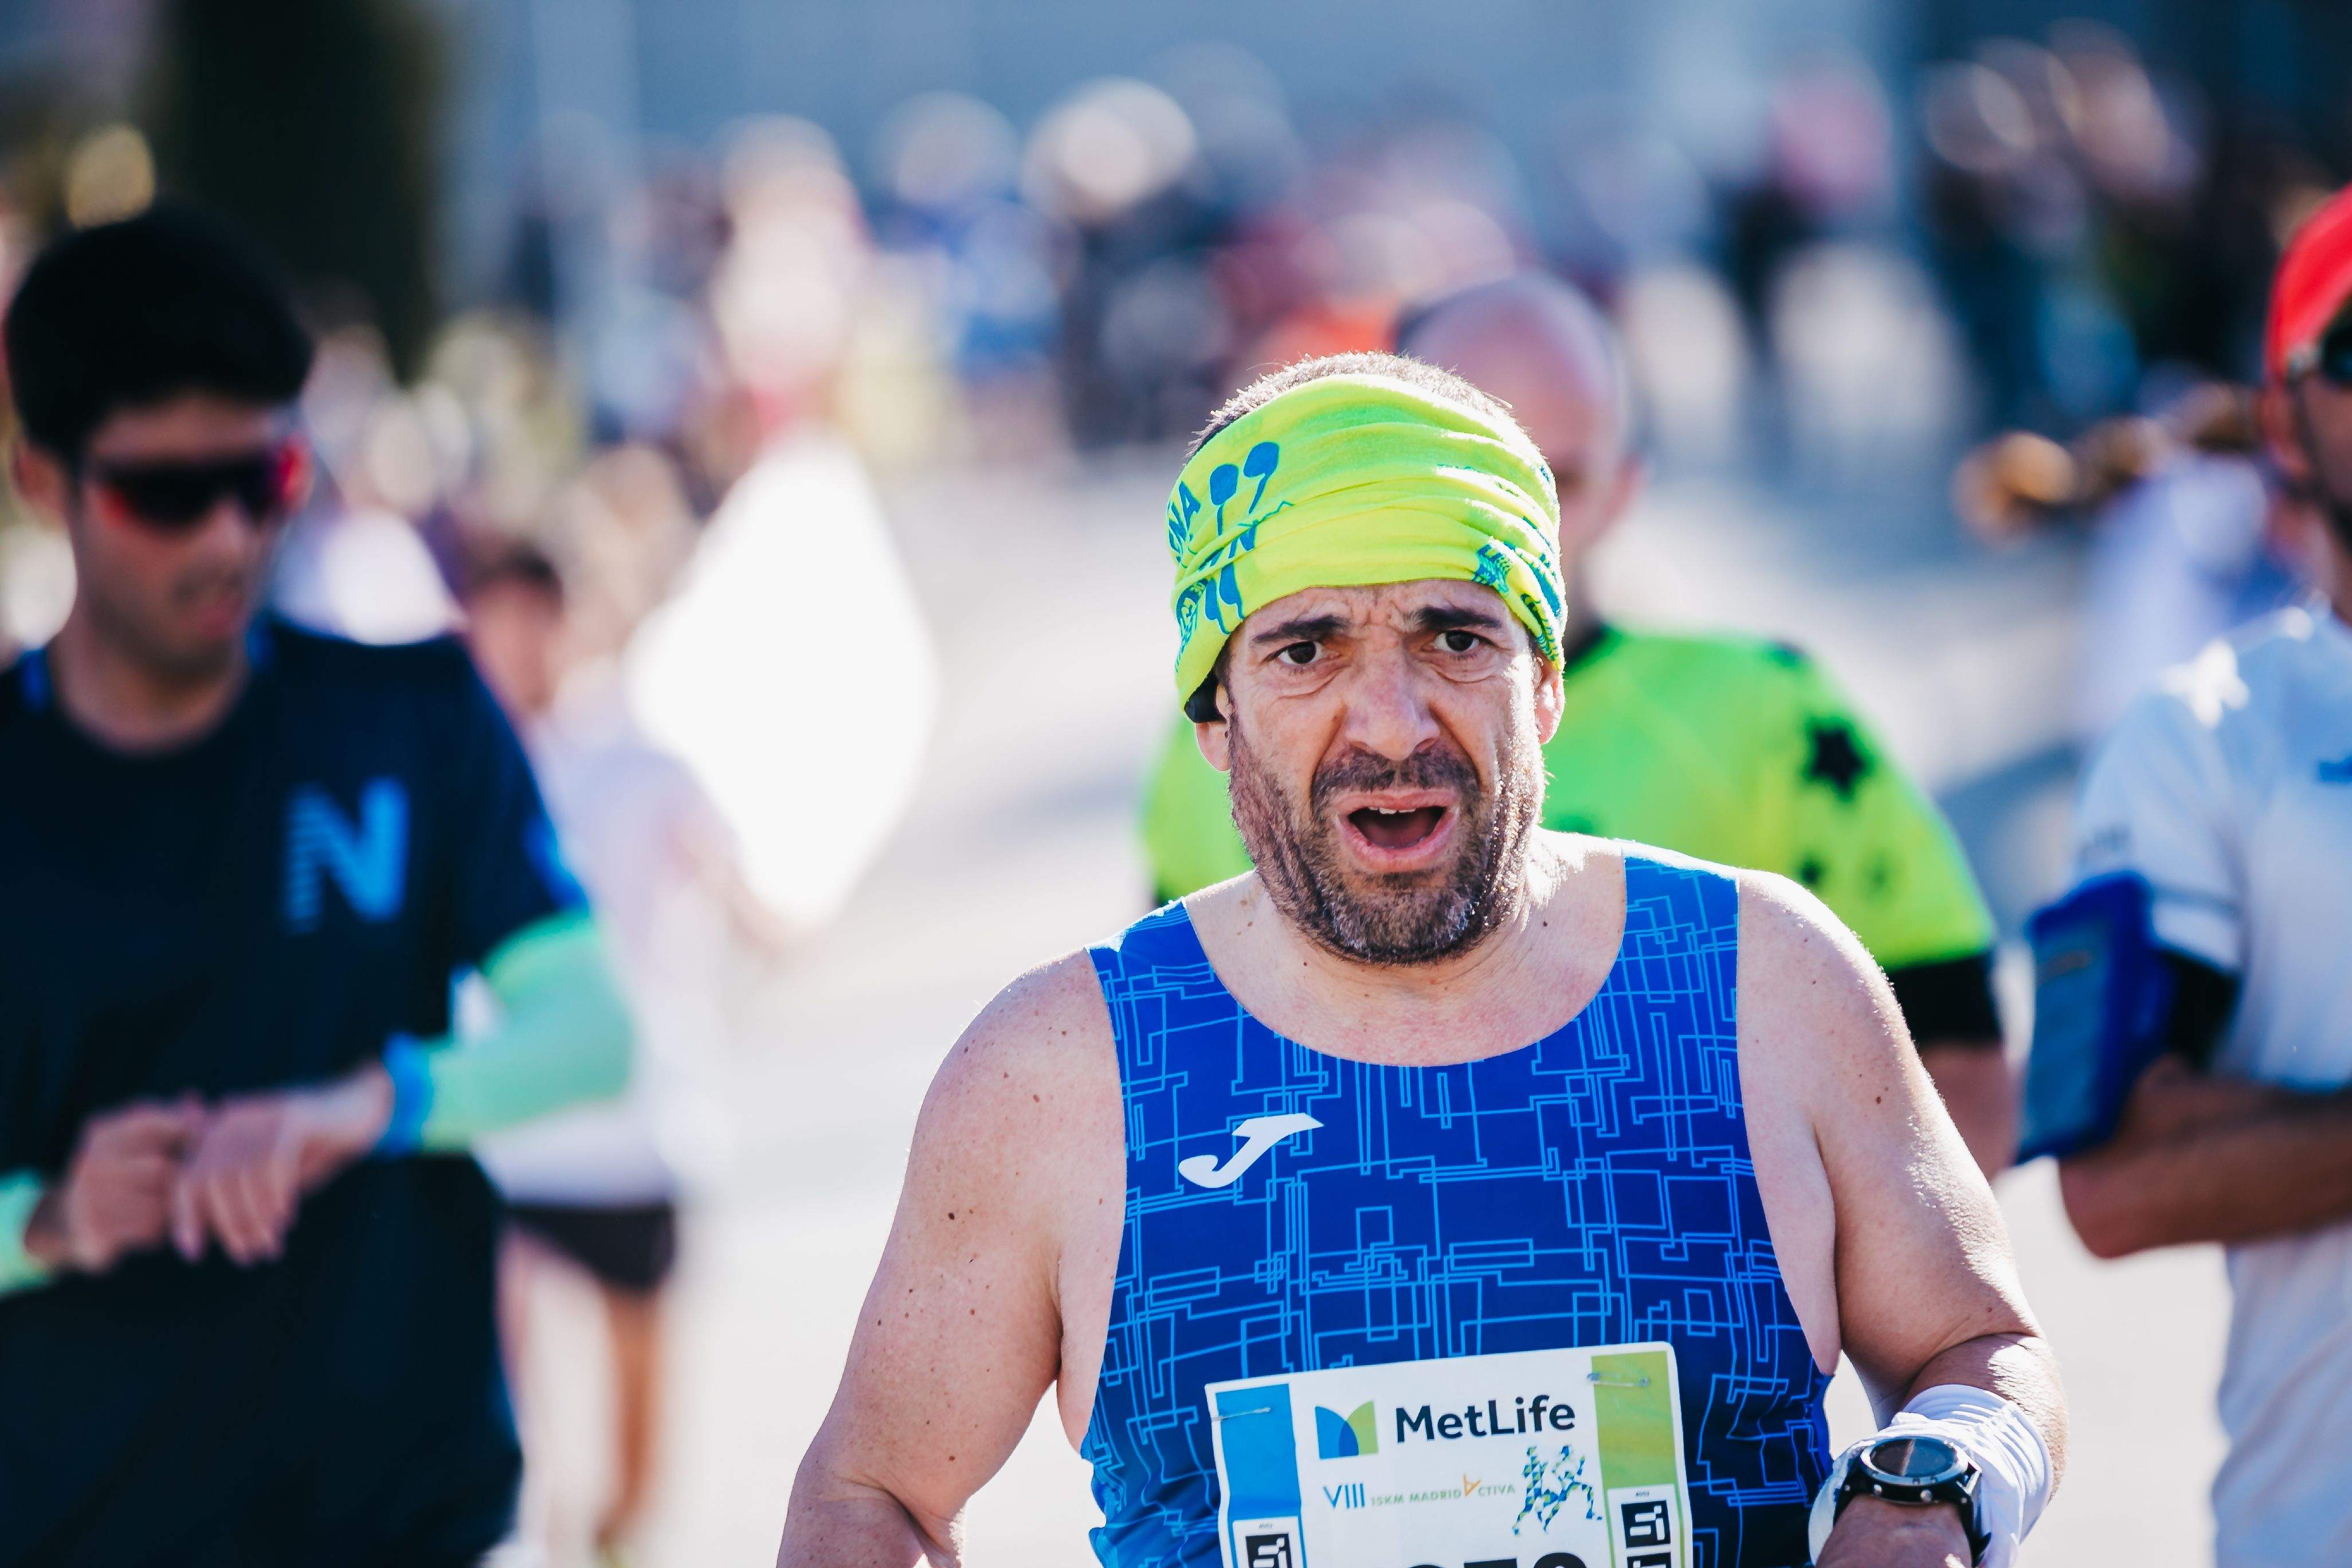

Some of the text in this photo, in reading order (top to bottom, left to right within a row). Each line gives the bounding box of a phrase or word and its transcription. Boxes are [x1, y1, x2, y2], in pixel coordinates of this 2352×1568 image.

[288, 776, 409, 931] N
[1395, 1395, 1575, 1443] MetLife
[1323, 1481, 1365, 1508] VIII
[1370, 1493, 1405, 1507] 15KM
[1409, 1489, 1461, 1504] MADRID
